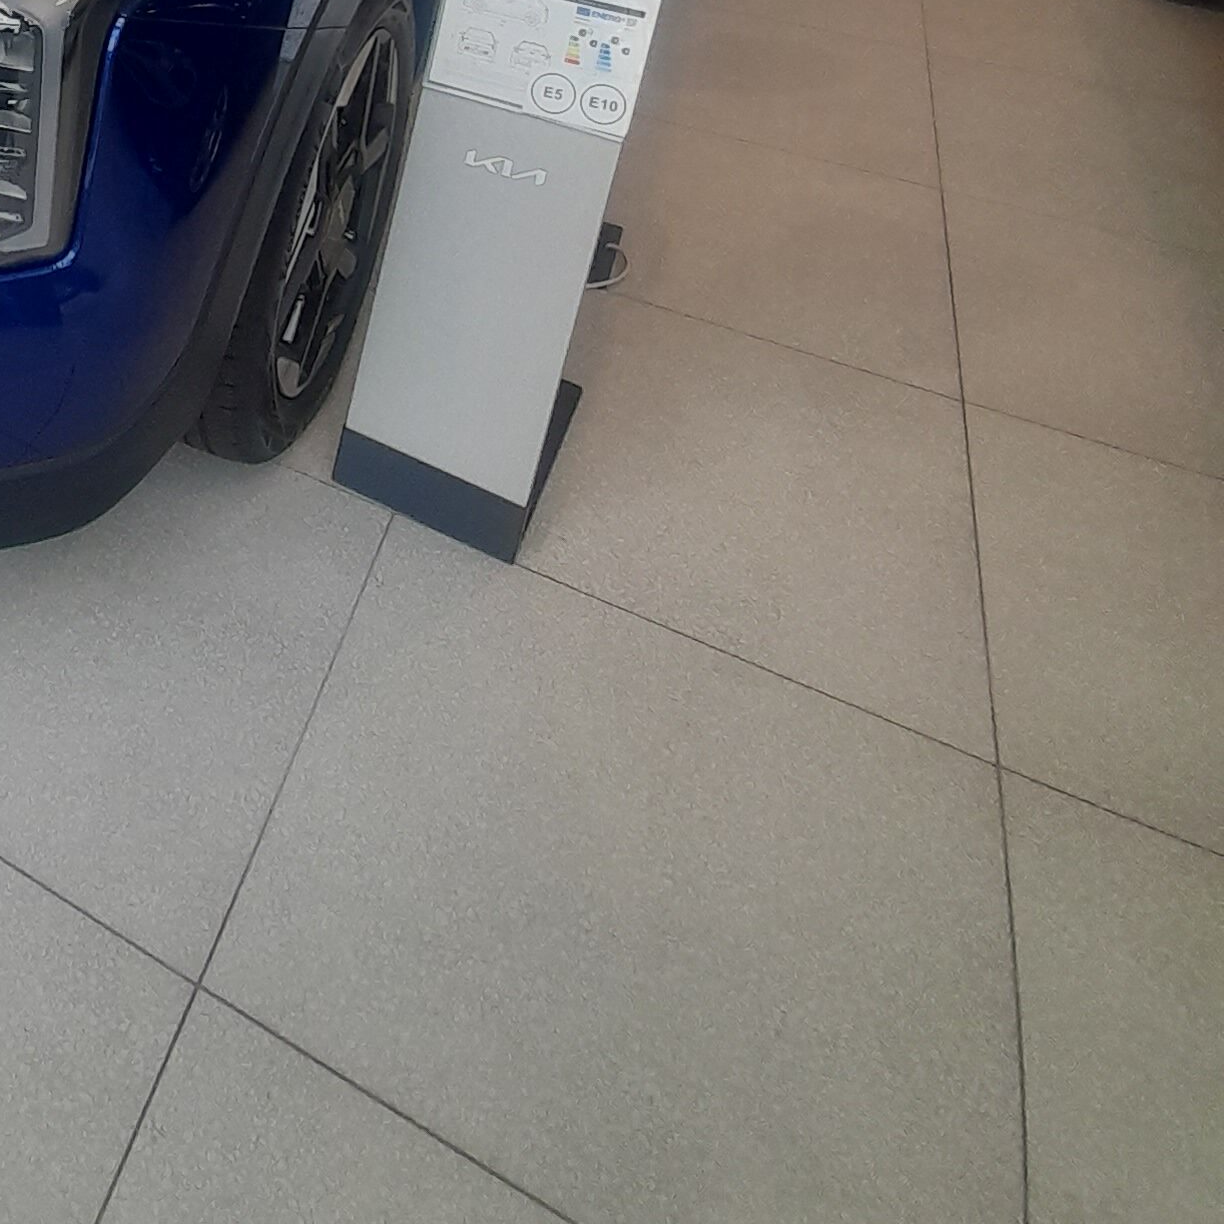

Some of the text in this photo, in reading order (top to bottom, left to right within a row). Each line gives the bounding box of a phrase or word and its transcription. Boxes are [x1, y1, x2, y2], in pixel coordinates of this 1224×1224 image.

[543, 86, 564, 101] E5
[588, 96, 618, 112] E10
[464, 149, 547, 186] KIA
